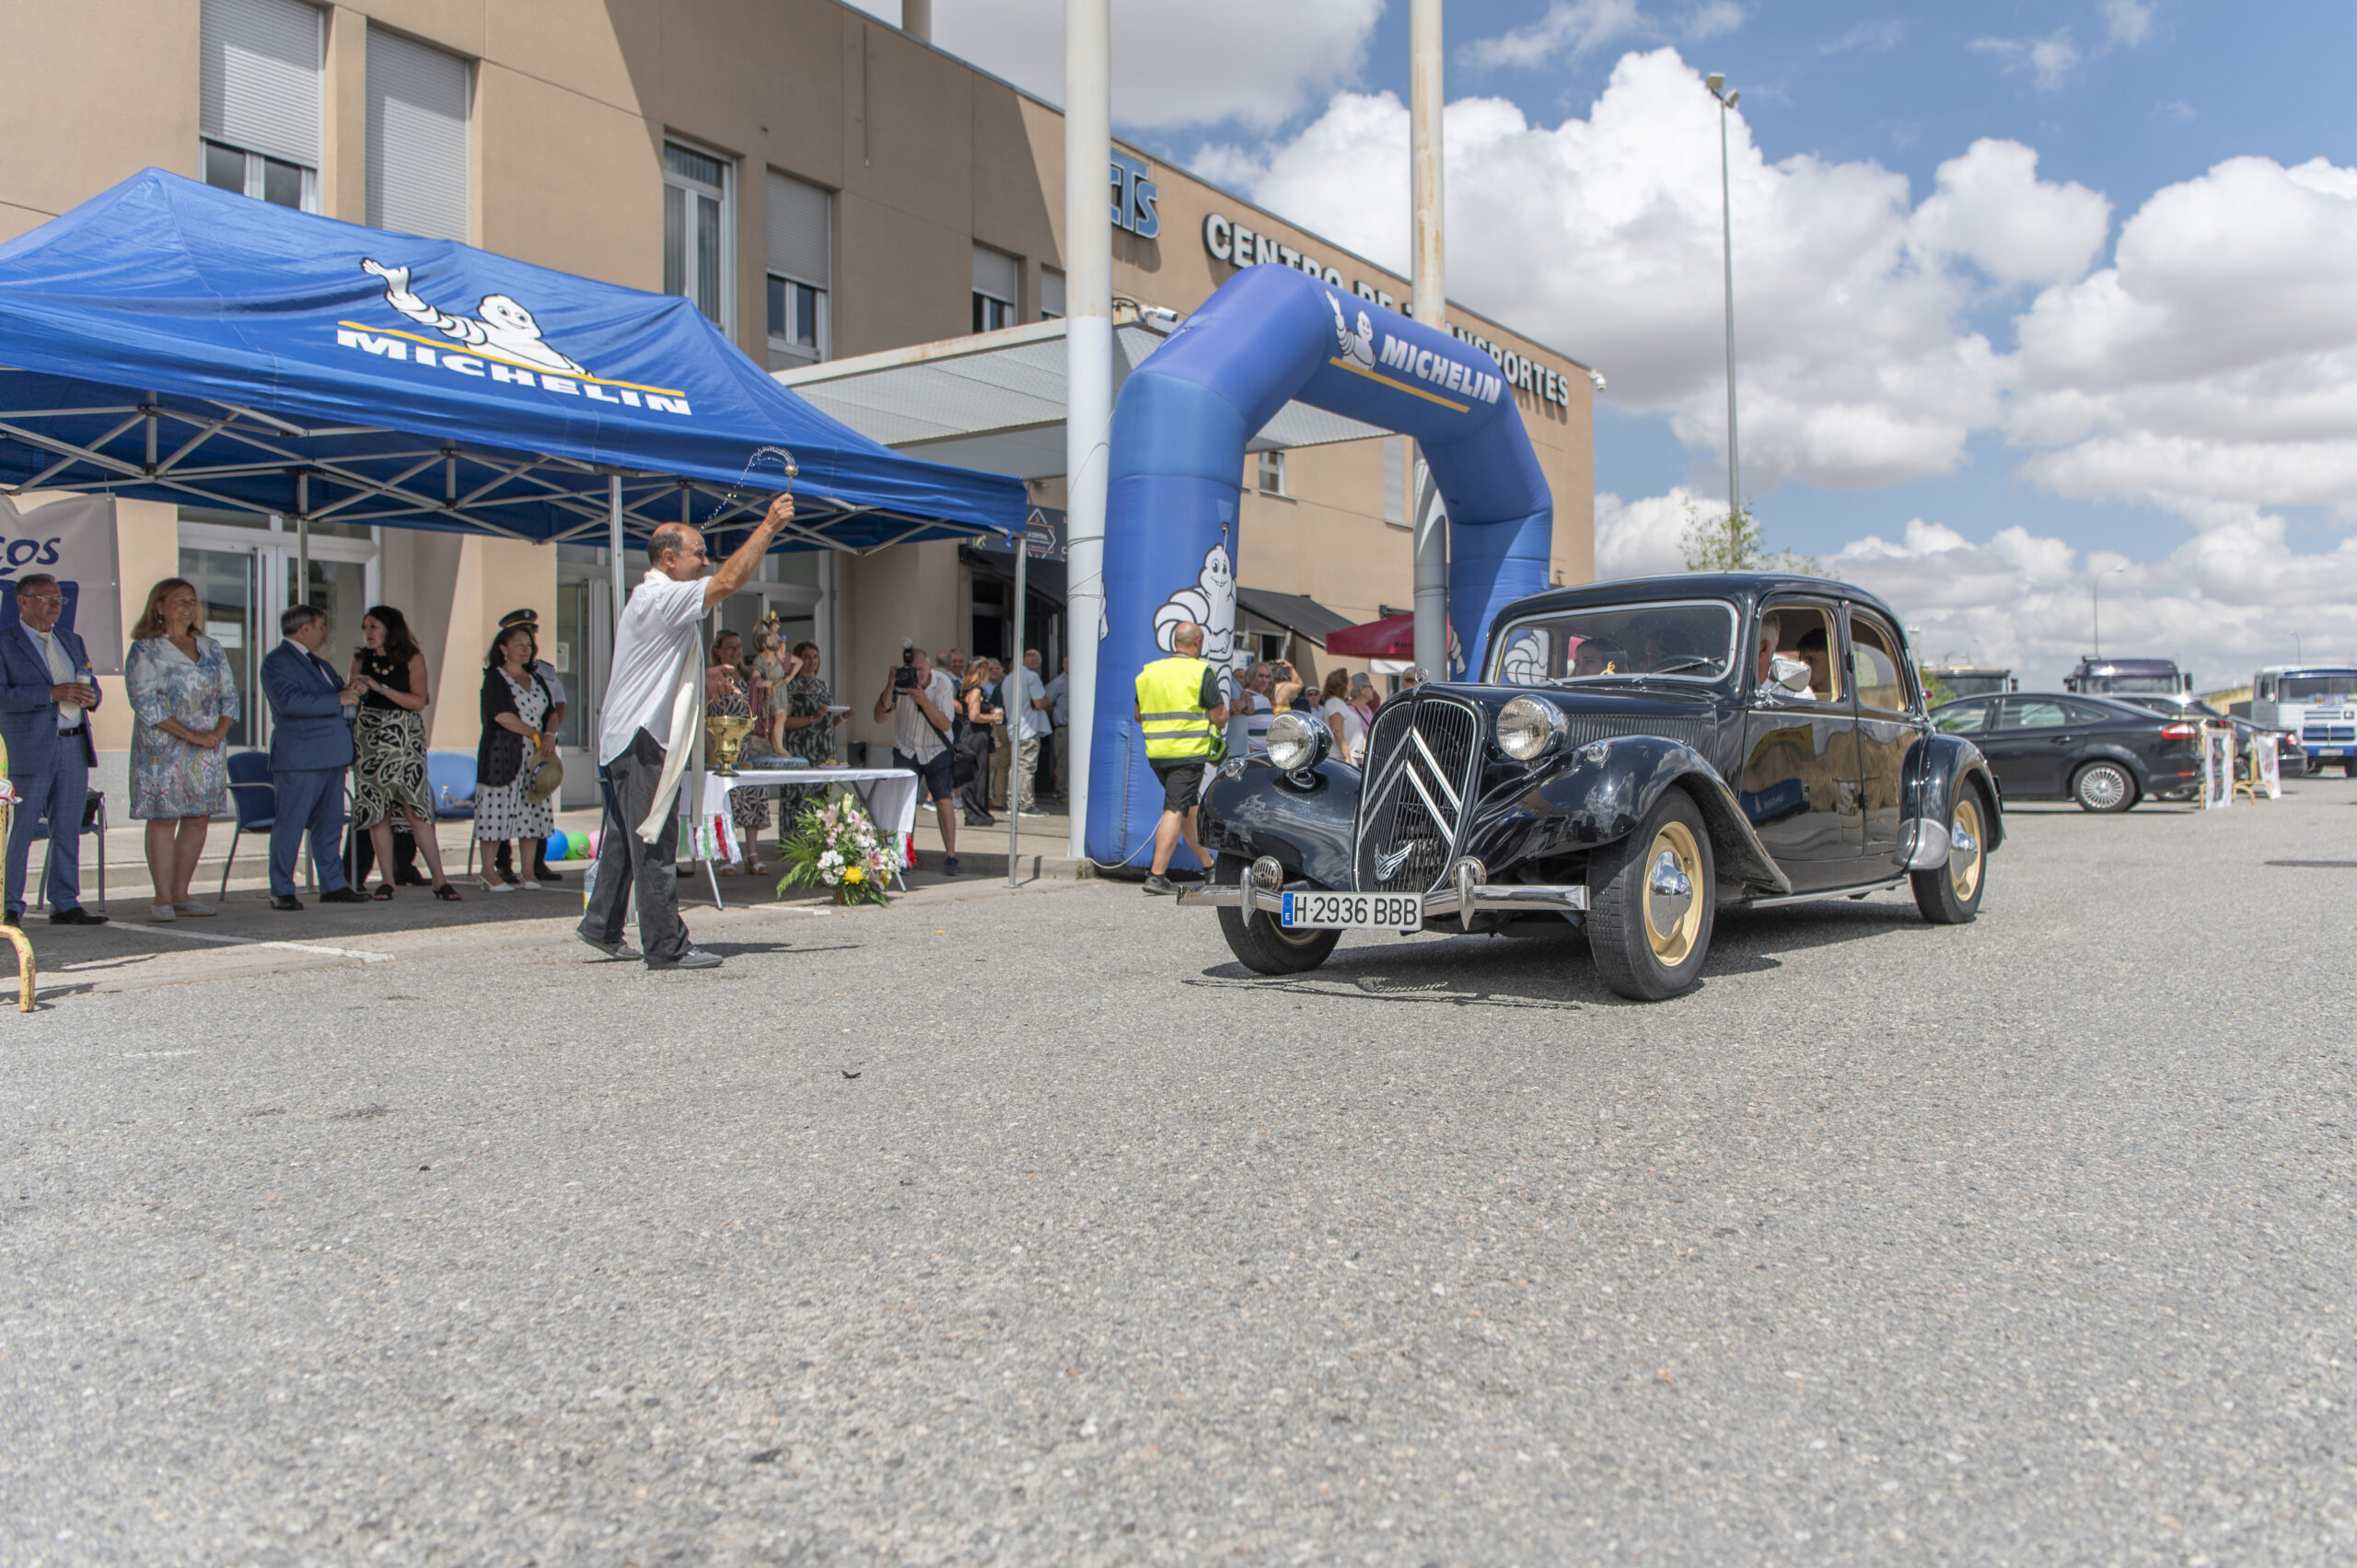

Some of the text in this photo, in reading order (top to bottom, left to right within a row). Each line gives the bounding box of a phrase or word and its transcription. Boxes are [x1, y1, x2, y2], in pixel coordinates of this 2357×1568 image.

[337, 329, 692, 416] MICHELIN
[1379, 333, 1502, 405] MICHELIN
[1284, 912, 1291, 921] E
[1374, 898, 1418, 926] BBB
